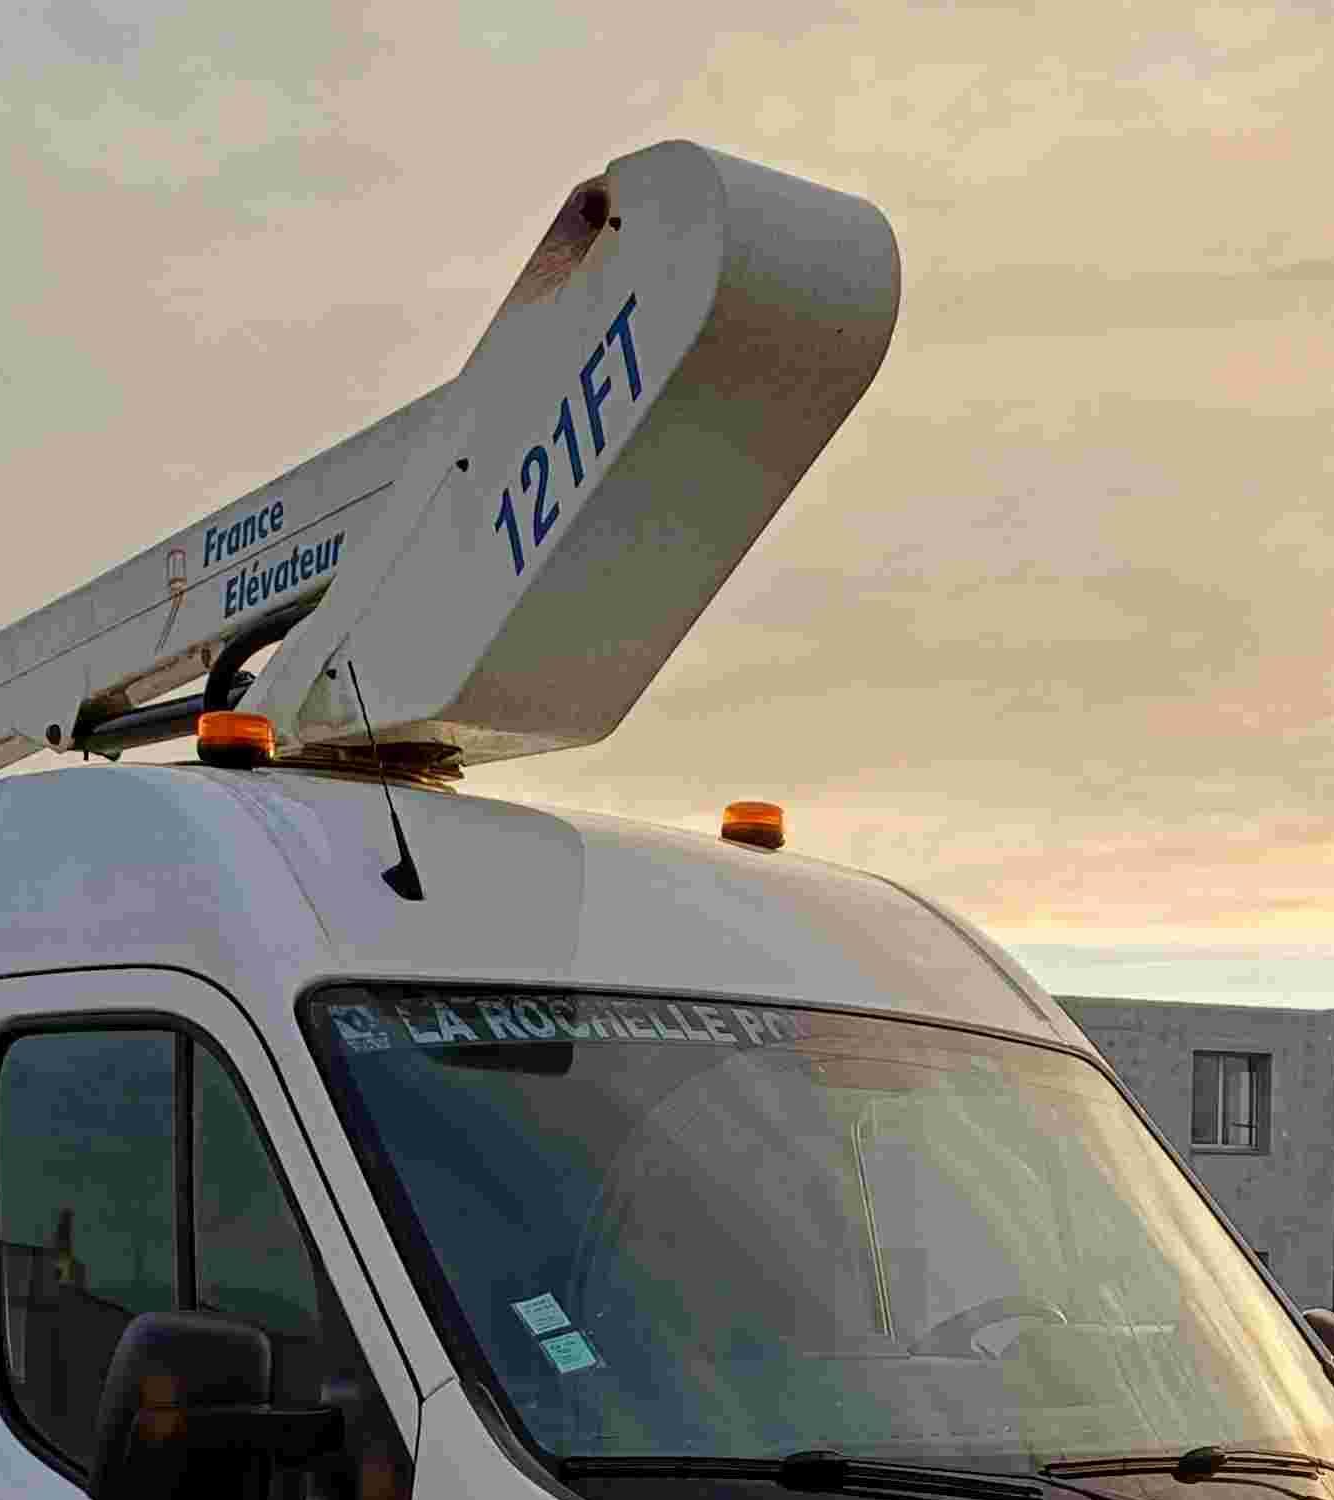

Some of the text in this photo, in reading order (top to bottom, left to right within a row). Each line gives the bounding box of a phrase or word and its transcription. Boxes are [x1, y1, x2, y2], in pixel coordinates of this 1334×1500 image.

[493, 292, 643, 577] 121FT
[202, 498, 284, 568] France
[223, 529, 346, 619] Elévateur
[397, 1001, 479, 1043] LA
[477, 999, 733, 1043] ROCHELLE
